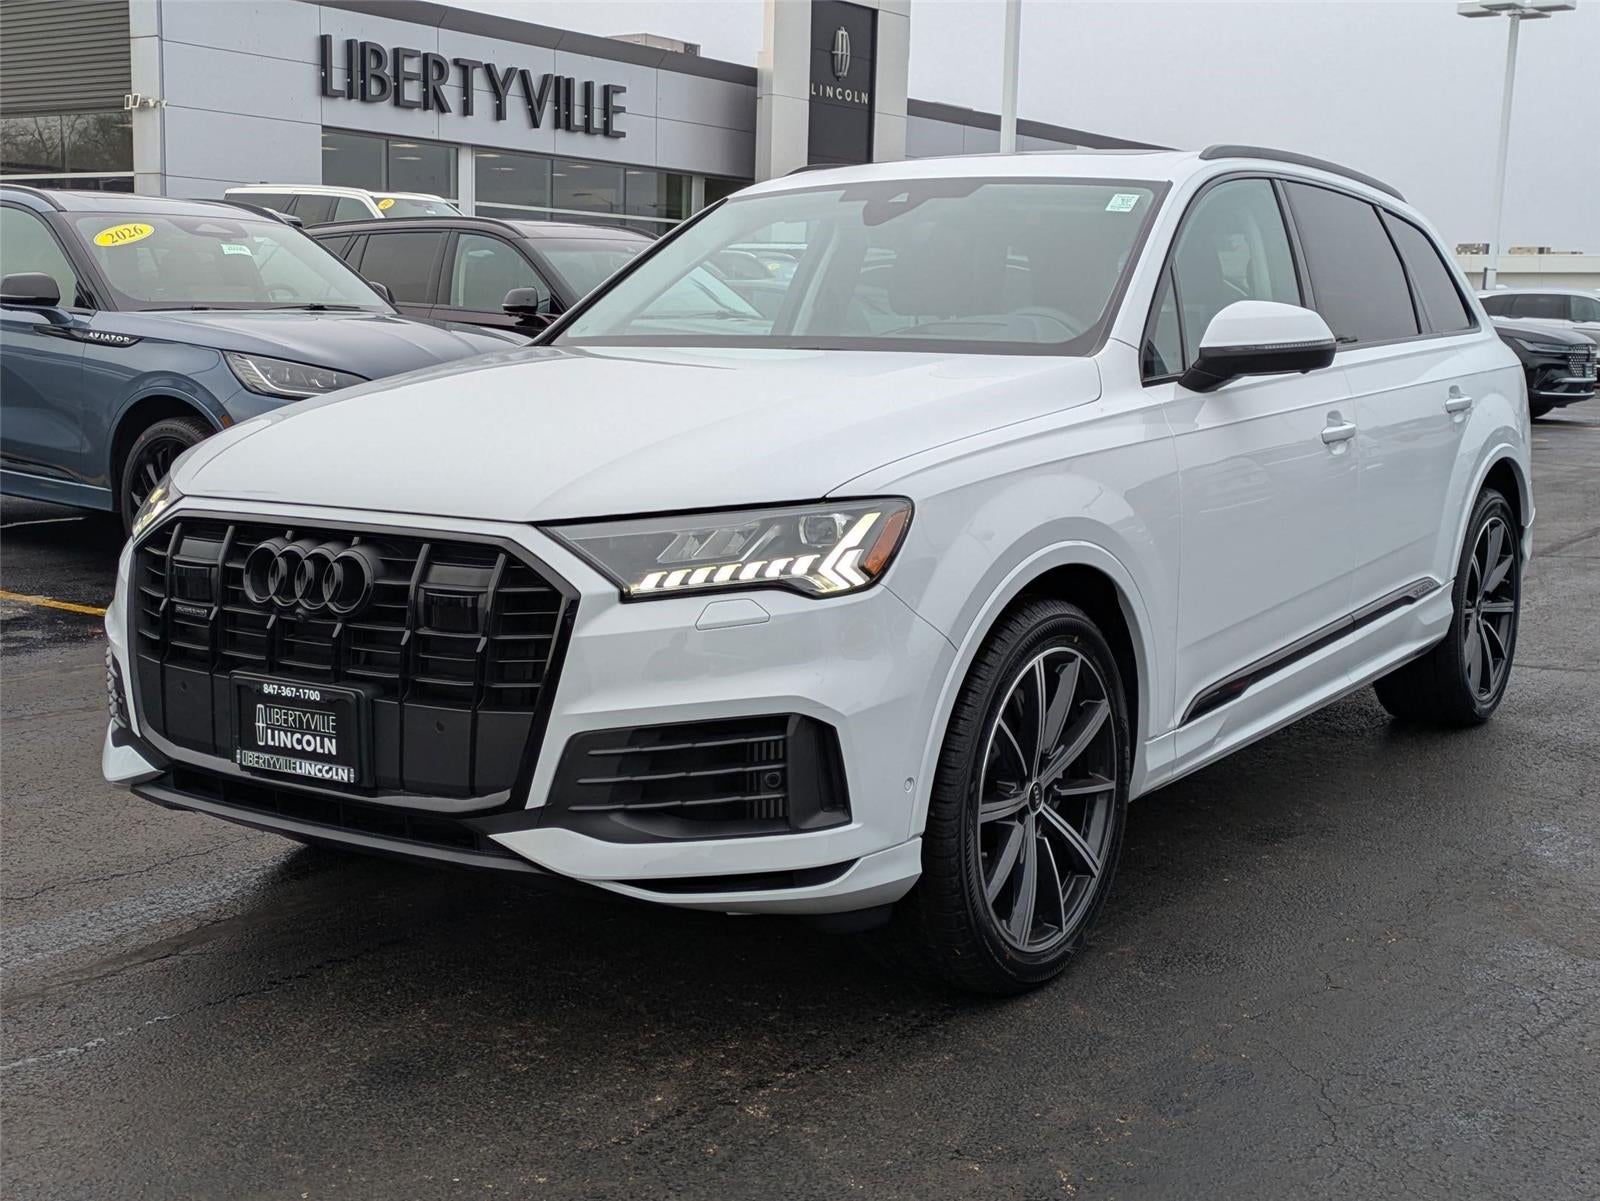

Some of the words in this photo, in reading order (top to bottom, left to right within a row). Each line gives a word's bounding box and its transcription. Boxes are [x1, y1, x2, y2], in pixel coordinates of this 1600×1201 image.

[320, 34, 627, 138] LIBERTYVILLE
[811, 83, 869, 104] LINCOLN
[106, 225, 144, 244] 2026
[89, 331, 130, 343] AVIATOR
[263, 683, 320, 701] 847-367-1700
[266, 707, 337, 734] LIBERTYVILLE
[267, 729, 337, 756] LINCOLN
